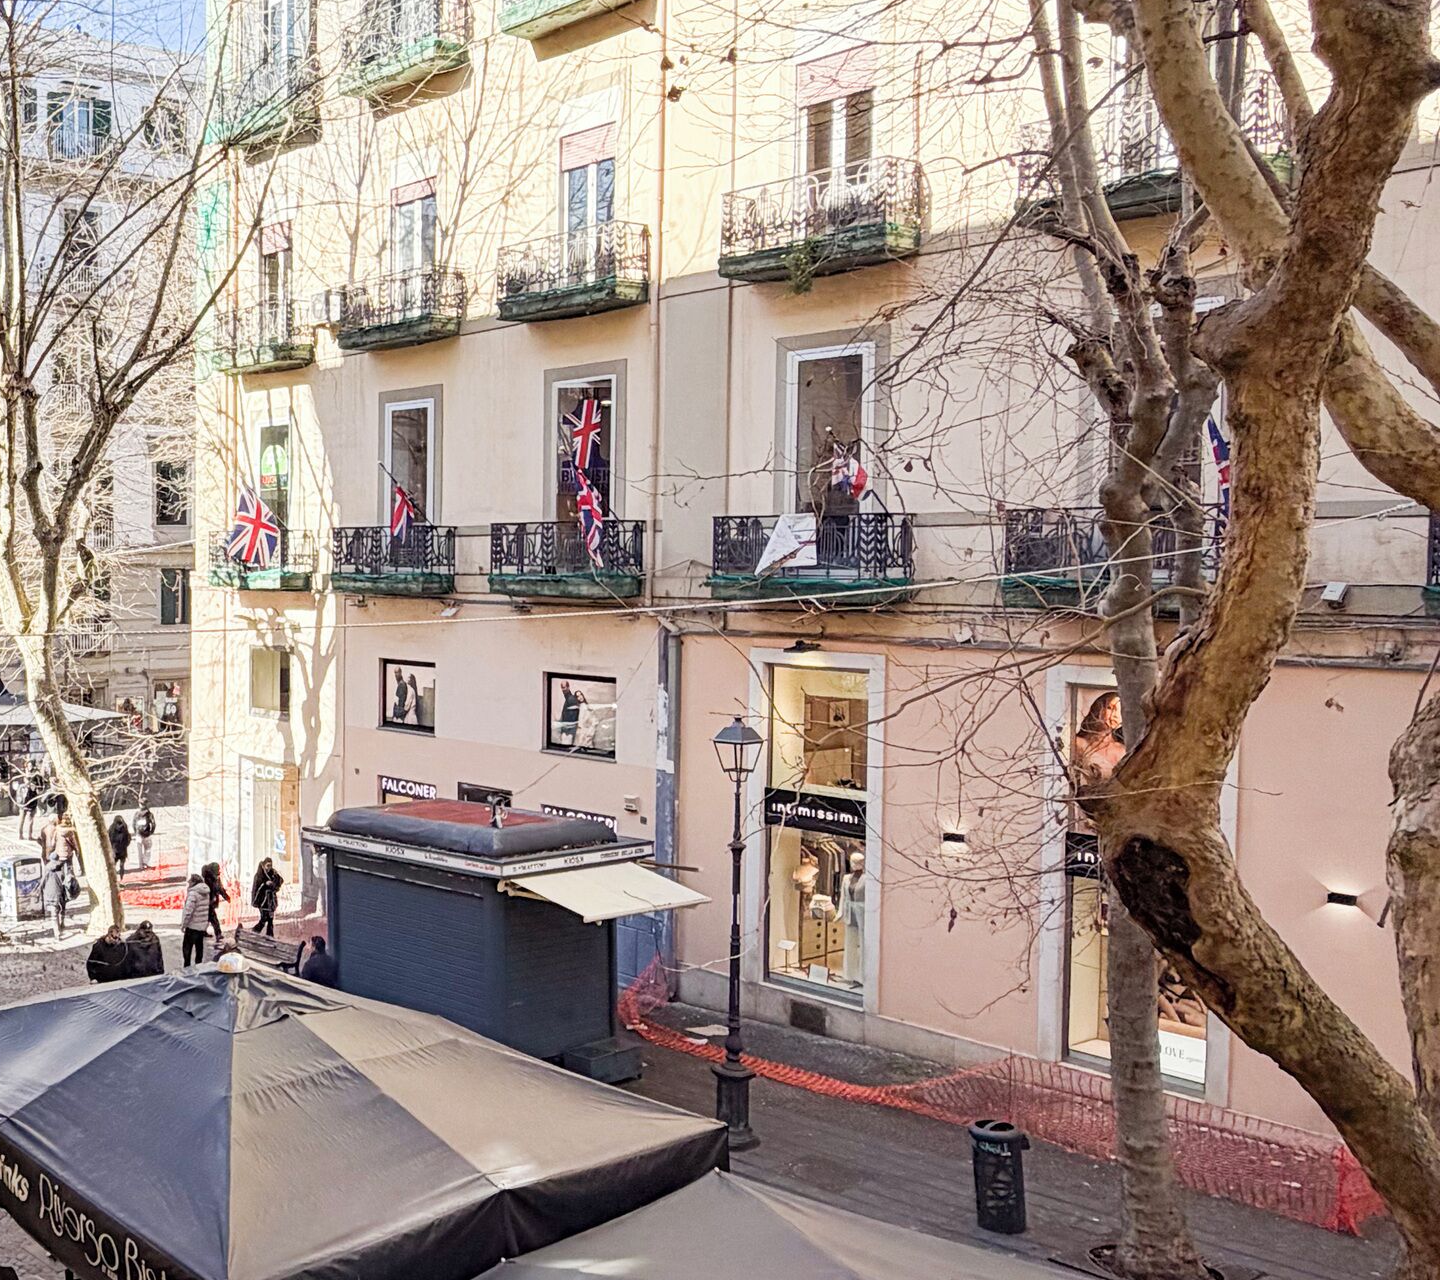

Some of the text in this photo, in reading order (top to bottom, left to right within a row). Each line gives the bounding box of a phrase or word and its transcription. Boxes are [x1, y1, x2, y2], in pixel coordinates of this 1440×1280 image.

[382, 777, 437, 800] FALCONER
[771, 802, 858, 825] intimissimi
[39, 1173, 120, 1272] Riverso
